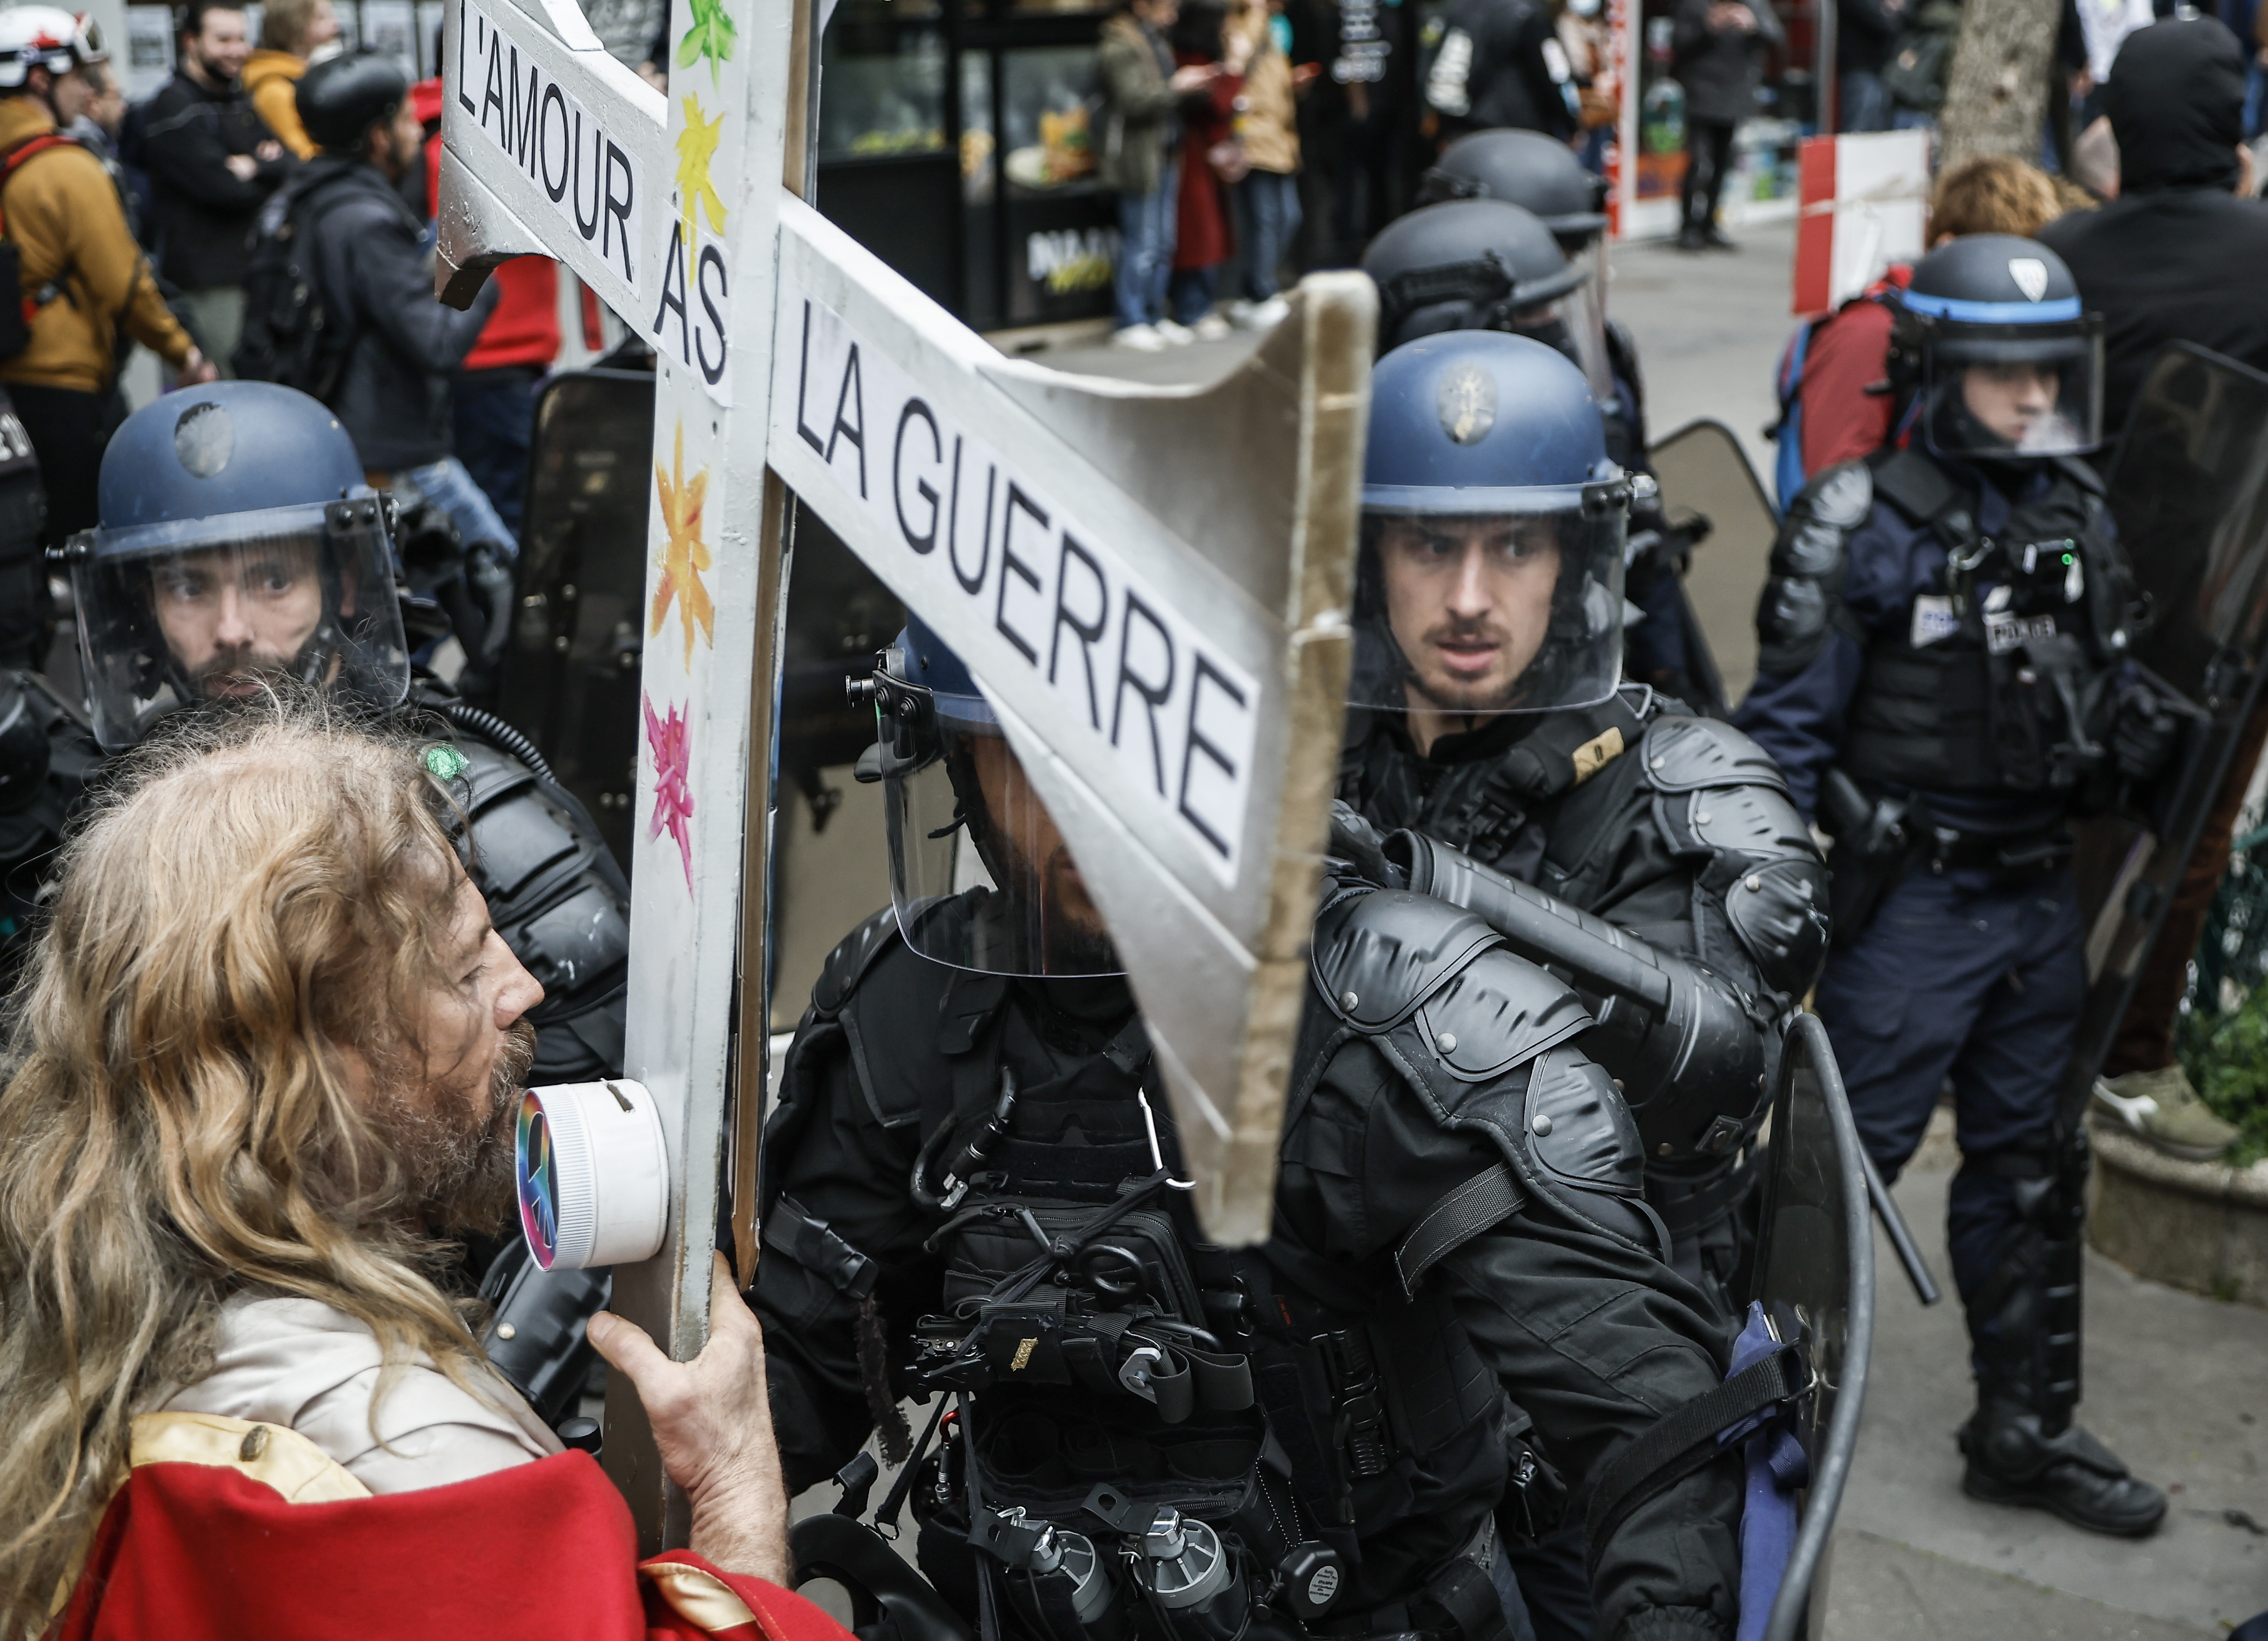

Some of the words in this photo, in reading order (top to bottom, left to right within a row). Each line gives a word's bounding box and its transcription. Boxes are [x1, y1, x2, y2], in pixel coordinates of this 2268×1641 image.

[459, 0, 632, 283] L'AMOUR
[653, 219, 728, 385] AS
[796, 299, 868, 500] LA
[892, 397, 1248, 862] GUERRE
